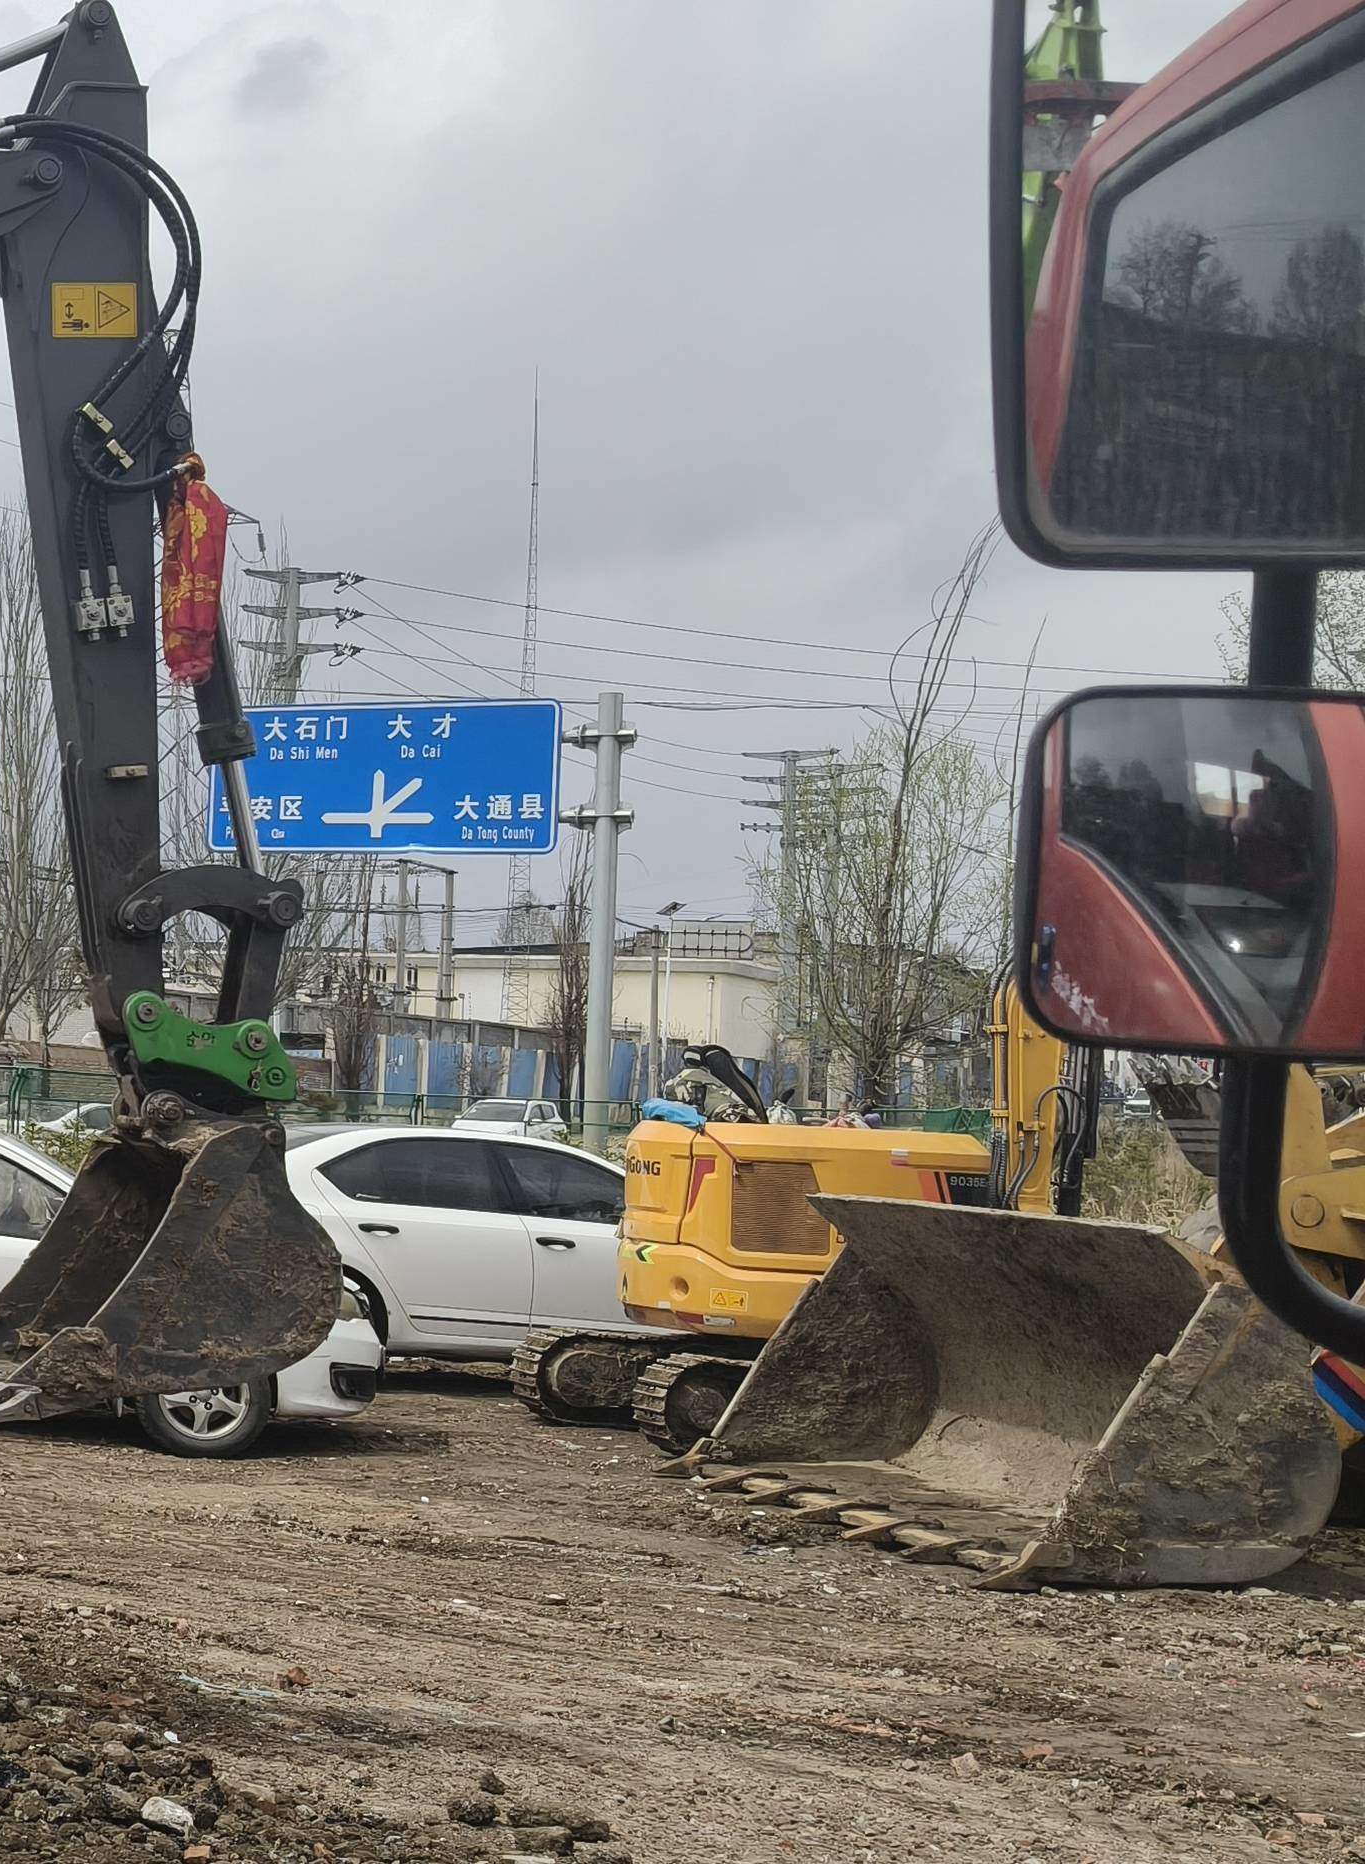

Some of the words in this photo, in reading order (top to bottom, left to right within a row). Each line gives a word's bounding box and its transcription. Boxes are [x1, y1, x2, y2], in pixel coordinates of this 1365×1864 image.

[263, 715, 348, 742] 大石门
[387, 712, 458, 740] 大才
[270, 747, 284, 760] Da
[290, 746, 310, 760] Shi
[315, 746, 339, 760] Men
[400, 744, 416, 759] Da
[422, 744, 442, 758] Cai
[453, 793, 545, 821] 大通县
[462, 826, 473, 840] Da
[477, 826, 498, 844] Tong
[502, 826, 535, 843] County
